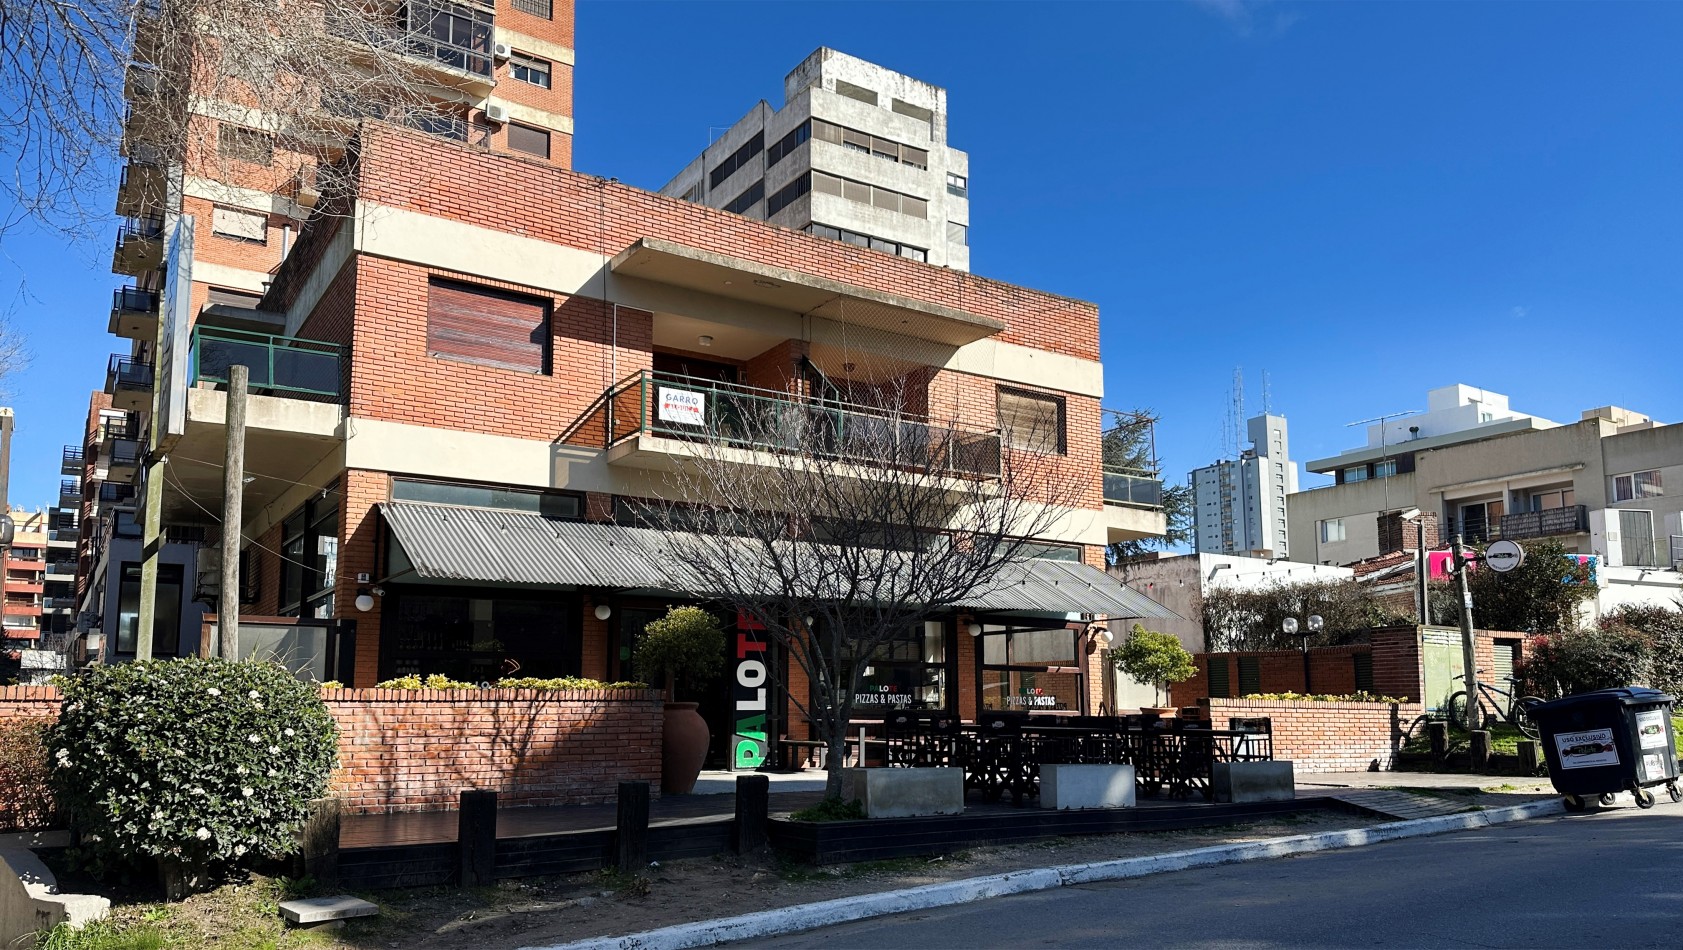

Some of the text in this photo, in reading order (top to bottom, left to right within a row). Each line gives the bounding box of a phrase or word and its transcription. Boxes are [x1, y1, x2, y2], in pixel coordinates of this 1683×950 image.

[665, 393, 699, 405] GARRO
[736, 606, 767, 768] PALOTE
[855, 693, 912, 704] PIZZAS & PASTAS
[1006, 696, 1027, 706] PIZZAS
[1027, 697, 1033, 706] &
[1033, 696, 1056, 706] PASTAS
[1575, 733, 1606, 742] EXCLUSIVO
